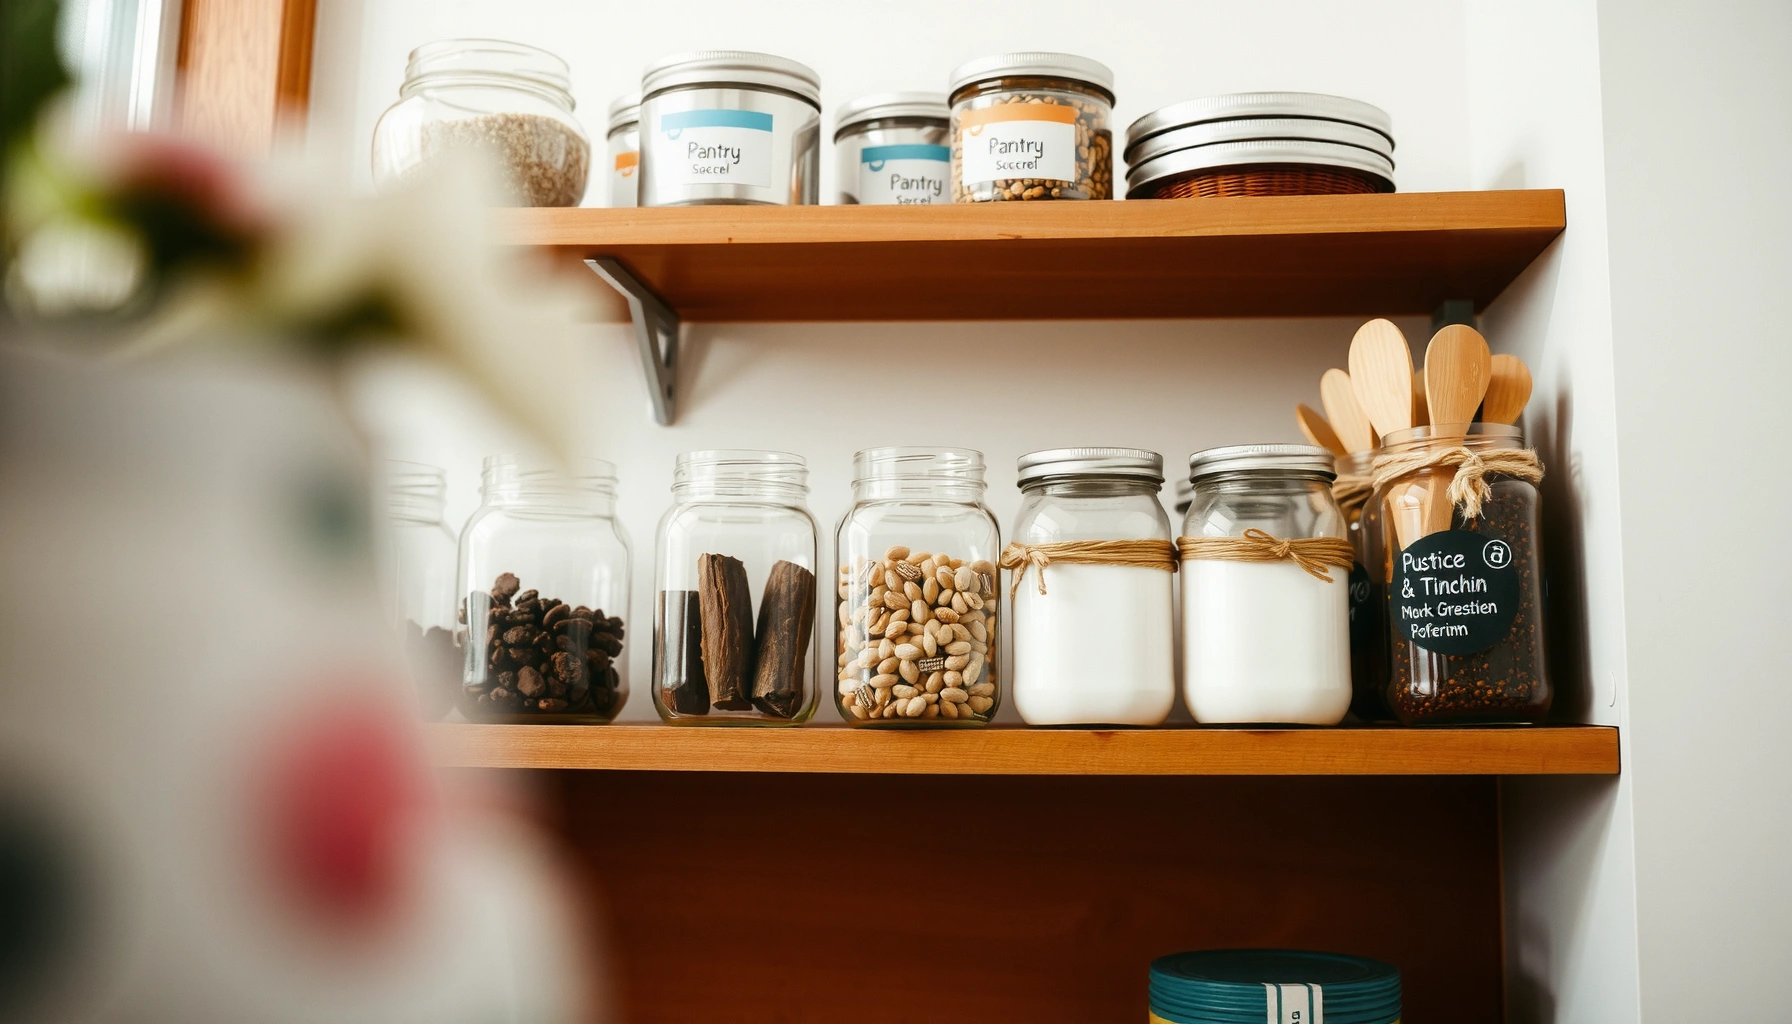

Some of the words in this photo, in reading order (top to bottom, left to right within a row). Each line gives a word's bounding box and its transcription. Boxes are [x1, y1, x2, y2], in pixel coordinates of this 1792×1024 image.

[688, 141, 741, 165] Pantry
[989, 137, 1043, 159] Pantry
[891, 173, 943, 197] Pantry
[1402, 551, 1466, 573] Pustice
[1401, 577, 1415, 599] &
[1420, 574, 1487, 596] Tinchin
